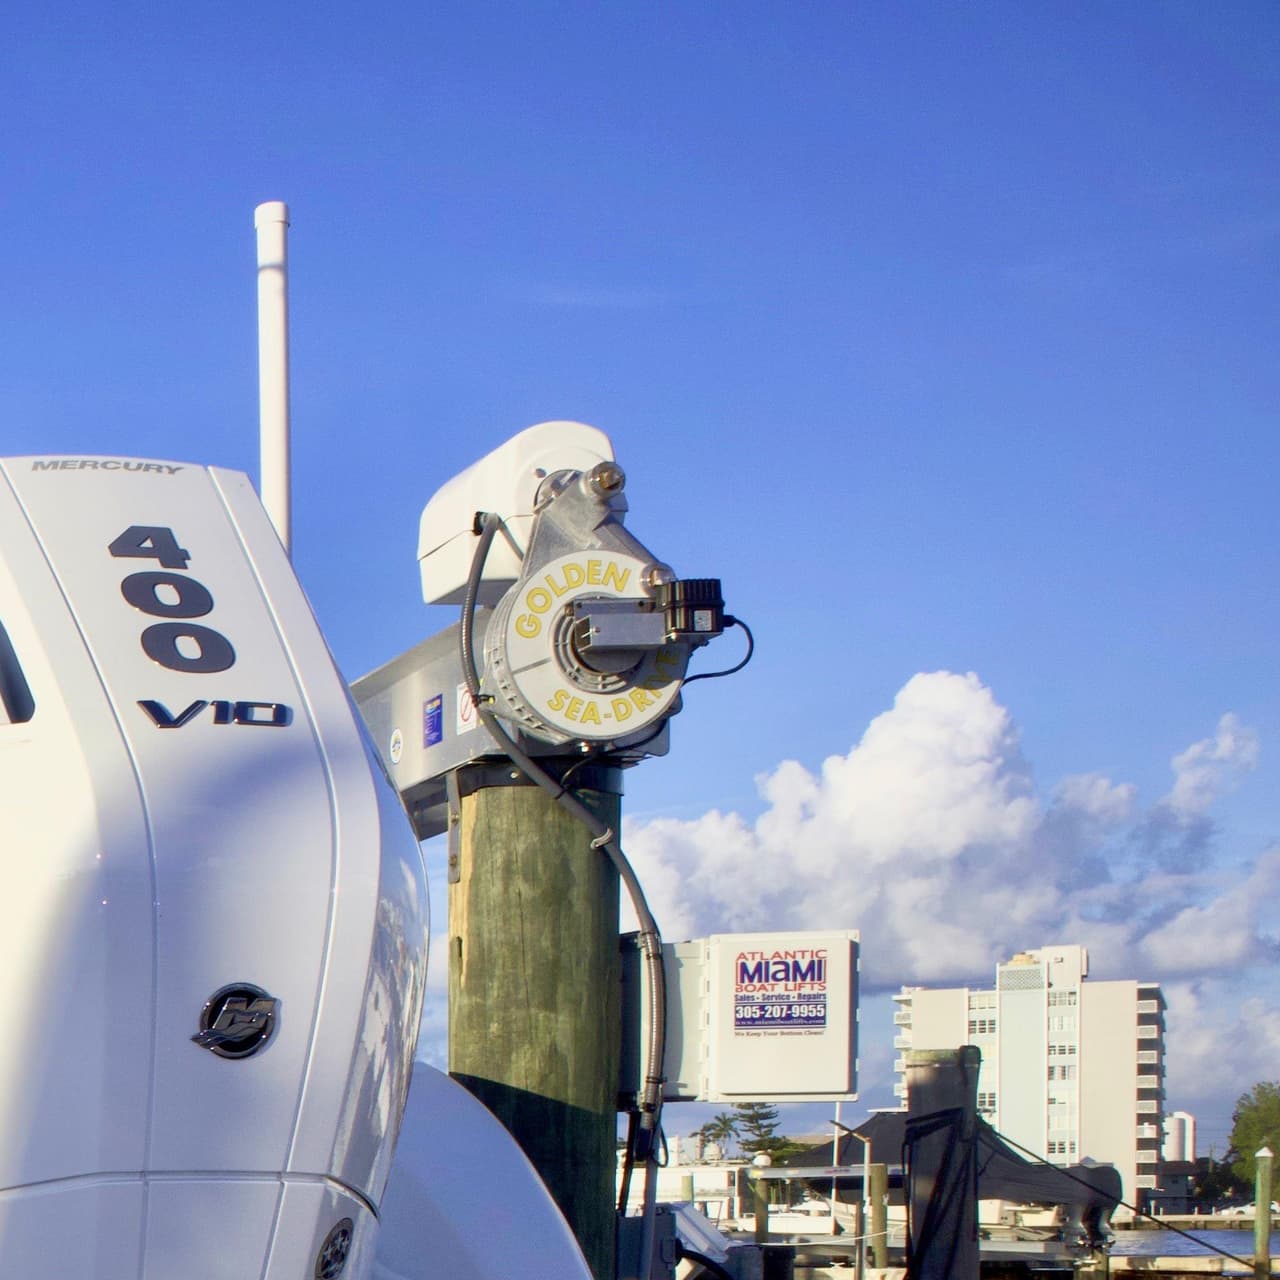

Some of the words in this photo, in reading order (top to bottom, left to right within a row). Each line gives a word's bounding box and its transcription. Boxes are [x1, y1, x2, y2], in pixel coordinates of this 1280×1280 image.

[32, 460, 185, 475] MERCURY
[108, 525, 236, 674] 400
[515, 560, 632, 639] GOLDEN
[547, 649, 679, 725] SEA-DRIVE
[137, 700, 290, 729] V10
[736, 949, 828, 960] ATLANTIC
[736, 983, 777, 993] BOAT
[784, 982, 826, 992] LIFTS
[761, 993, 790, 1001] Service
[797, 993, 827, 1002] Repairs
[736, 1005, 825, 1018] 305-207-9955
